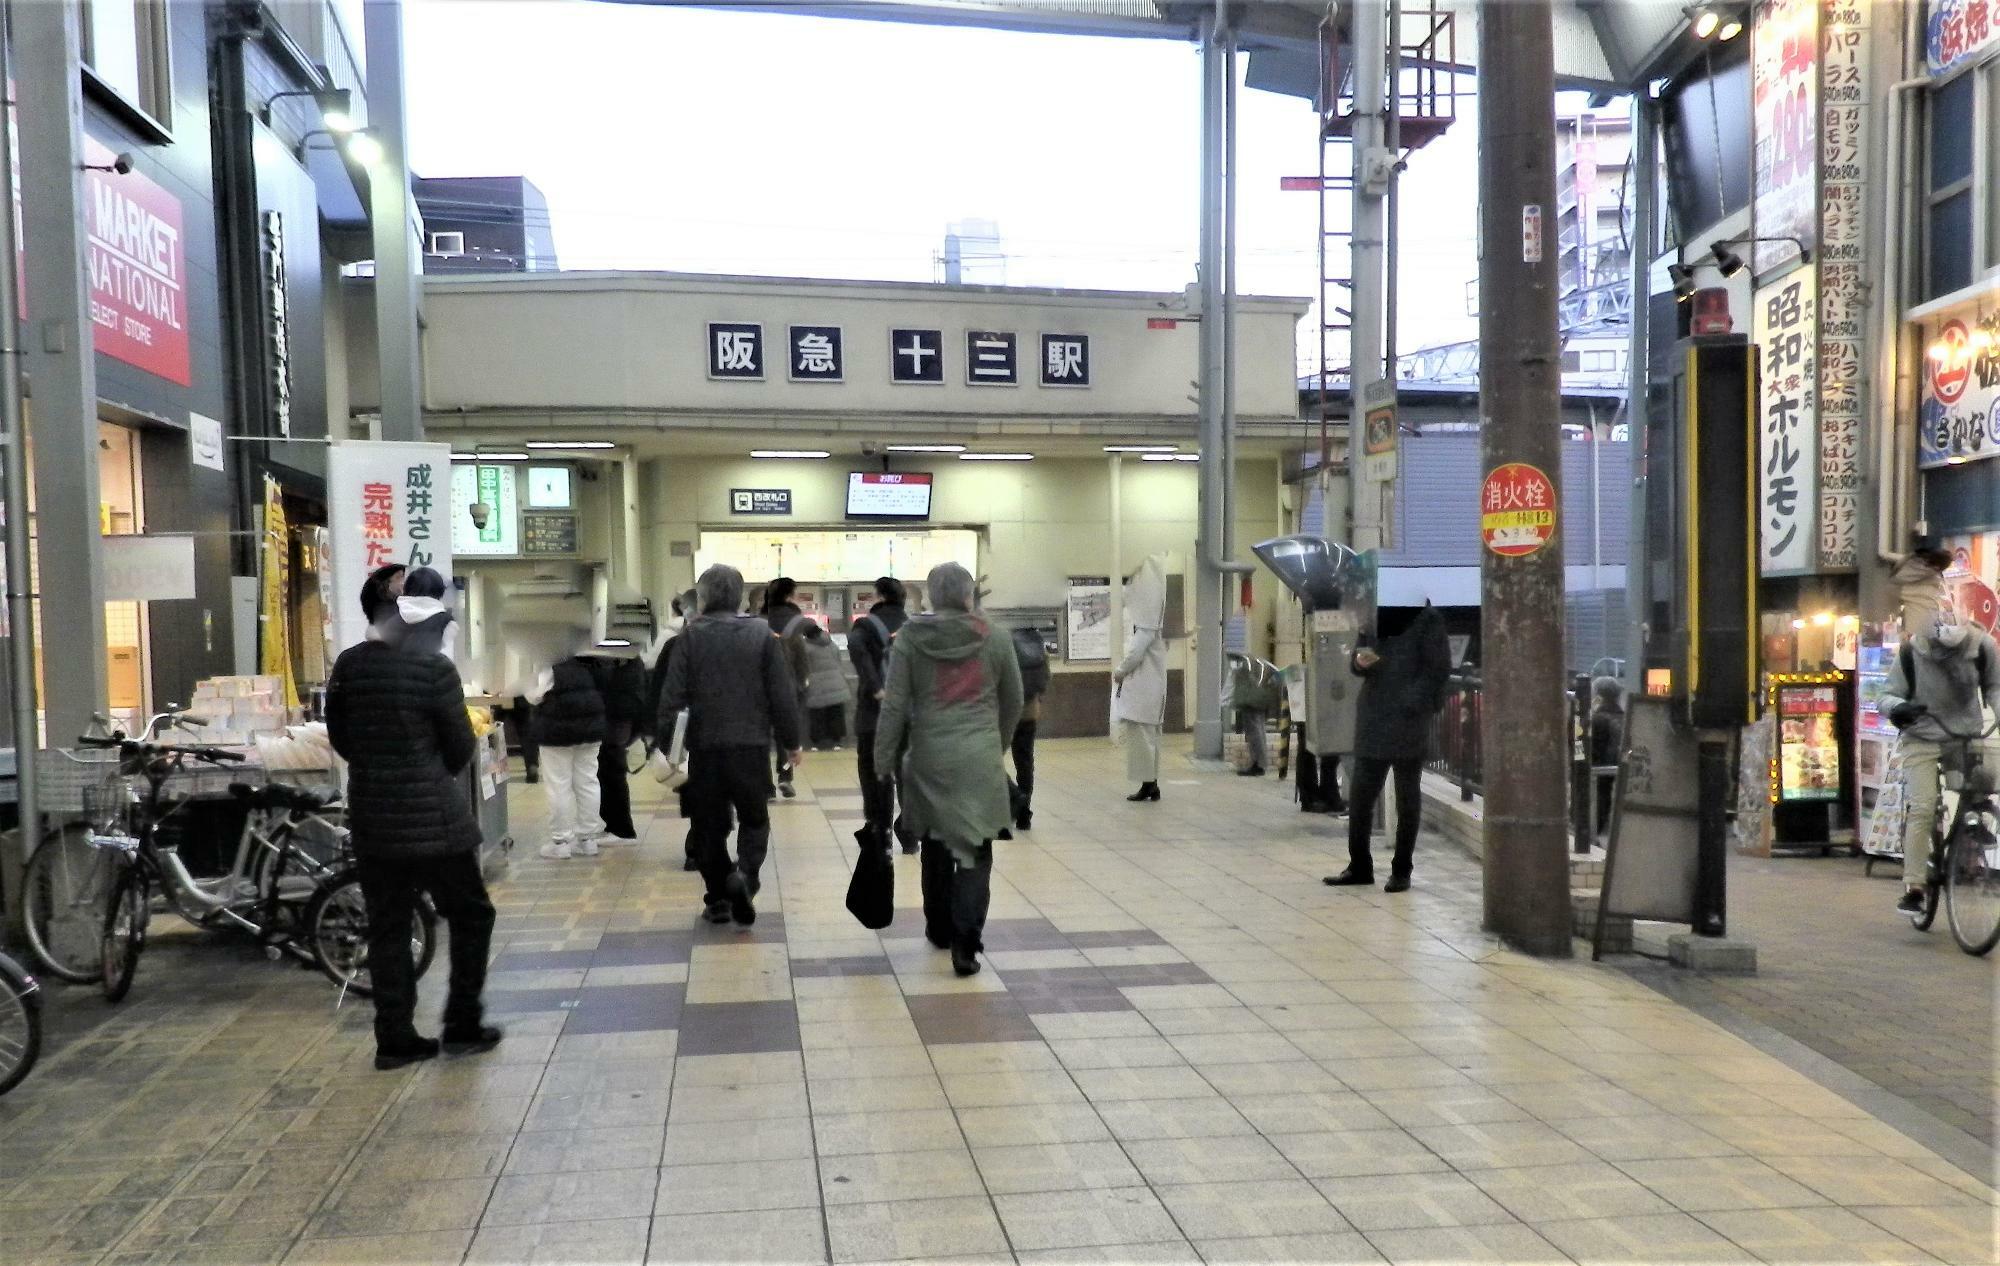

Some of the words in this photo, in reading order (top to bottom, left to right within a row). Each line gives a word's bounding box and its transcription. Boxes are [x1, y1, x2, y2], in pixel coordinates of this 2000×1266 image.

[1825, 32, 1842, 84] バラ
[1845, 32, 1861, 83] ロース
[1845, 107, 1859, 162] ガツミノ
[94, 177, 178, 280] MARKET
[91, 300, 119, 331] ELECT
[124, 315, 152, 346] STORE
[1767, 281, 1802, 377] 昭和
[716, 330, 1084, 380] 阪急十三駅
[1842, 344, 1859, 396] ハラミ
[1768, 374, 1800, 398] 大衆
[1842, 419, 1858, 473] アキレス
[1936, 412, 1985, 450] さかな
[754, 492, 788, 502] 西改札口
[1486, 479, 1546, 510] 消火栓
[1766, 395, 1800, 558] ホルモン
[364, 482, 393, 577] 完熟た
[406, 463, 433, 566] 成井さん
[1823, 496, 1838, 549] コリコリ
[1841, 496, 1857, 549] ハチノス
